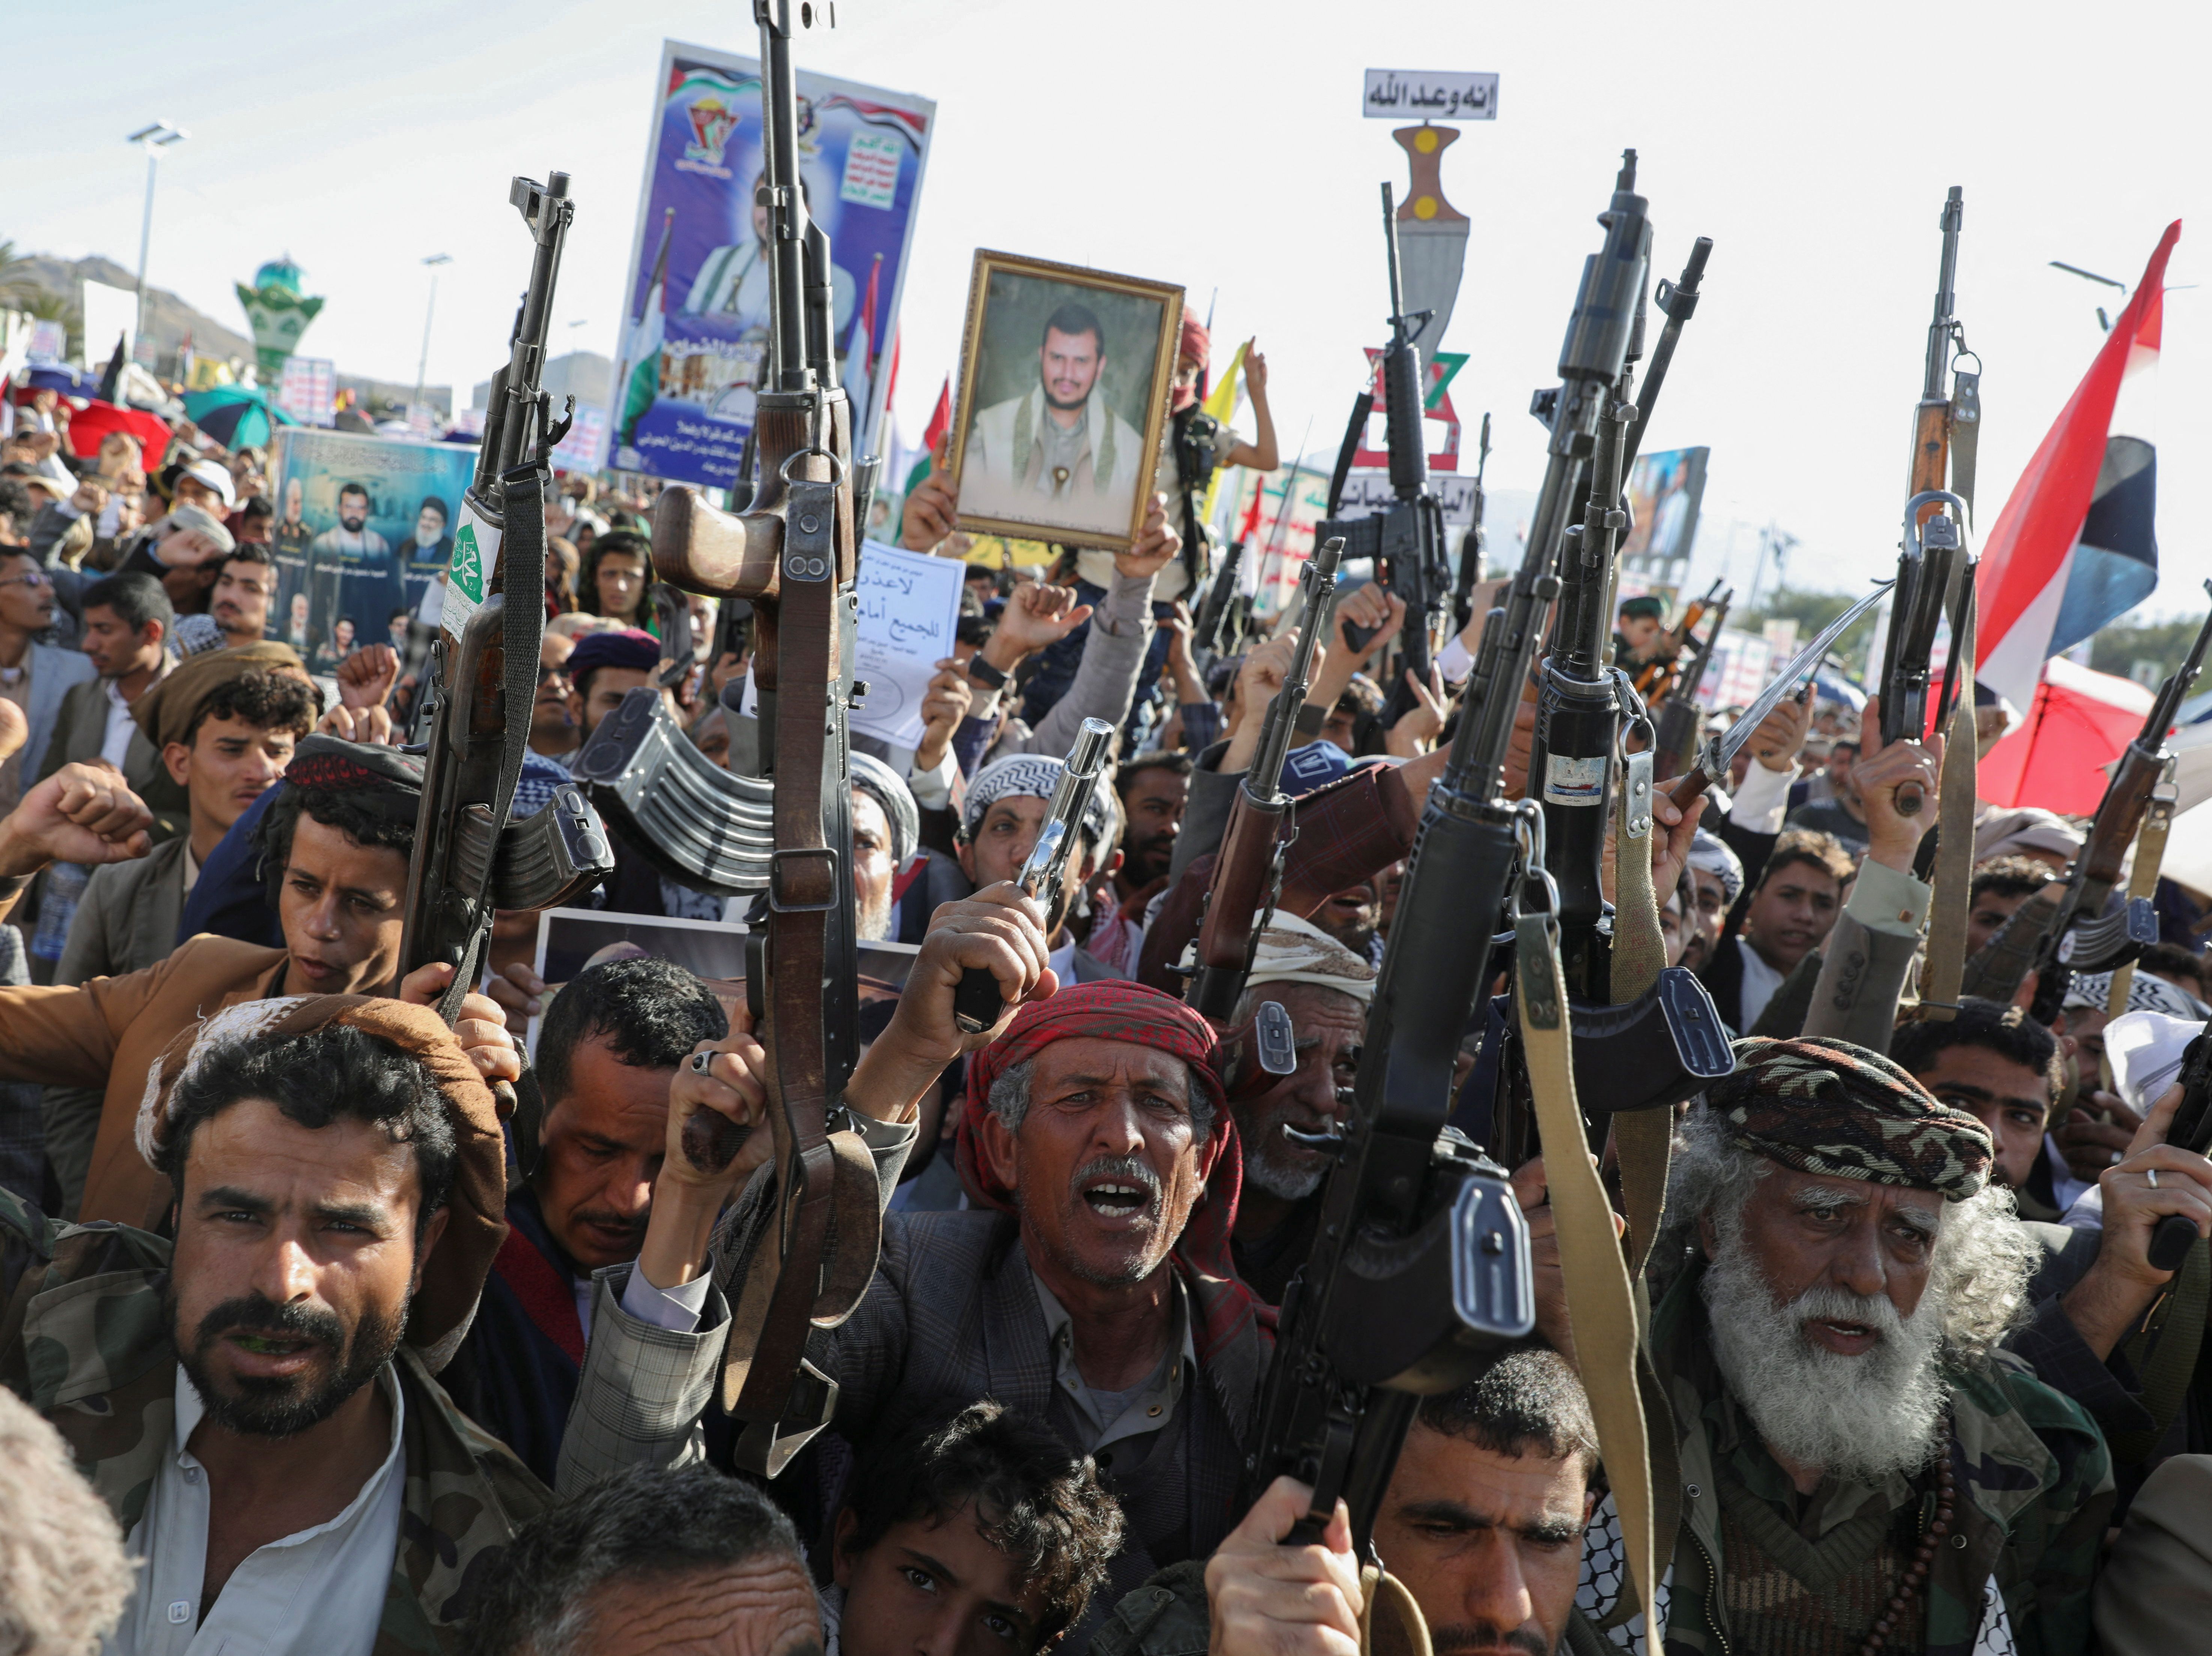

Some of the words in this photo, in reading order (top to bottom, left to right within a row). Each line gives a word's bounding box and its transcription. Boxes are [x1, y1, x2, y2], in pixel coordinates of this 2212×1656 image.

[1369, 72, 1408, 106] الله
[1409, 83, 1459, 116] وعد
[1462, 83, 1495, 119] إنه
[858, 596, 885, 620] أمام
[888, 618, 939, 642] للجميع
